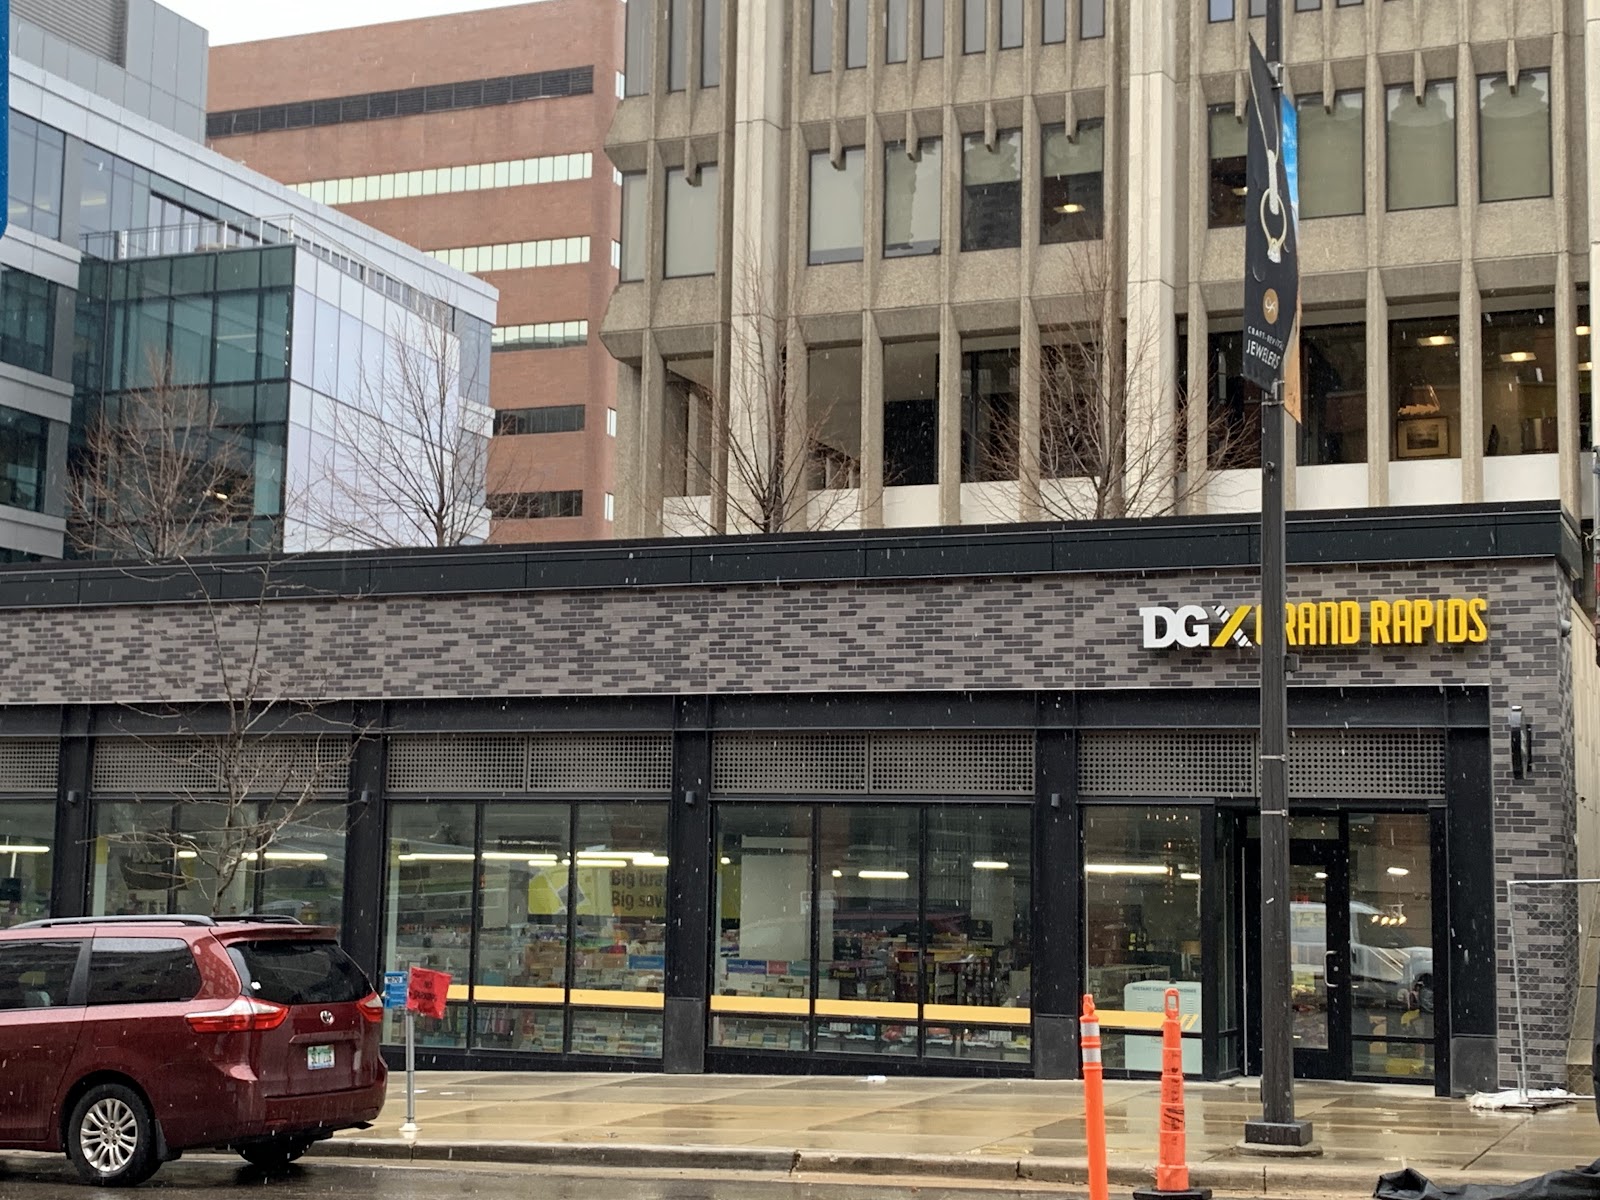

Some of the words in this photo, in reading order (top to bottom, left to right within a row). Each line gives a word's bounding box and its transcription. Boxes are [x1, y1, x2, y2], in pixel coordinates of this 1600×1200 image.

[1246, 339, 1280, 369] JEWELERS
[1139, 604, 1253, 648] DGX
[1256, 601, 1361, 646] RAND
[1370, 598, 1488, 644] RAPIDS
[611, 869, 635, 889] Big
[611, 890, 634, 911] Big
